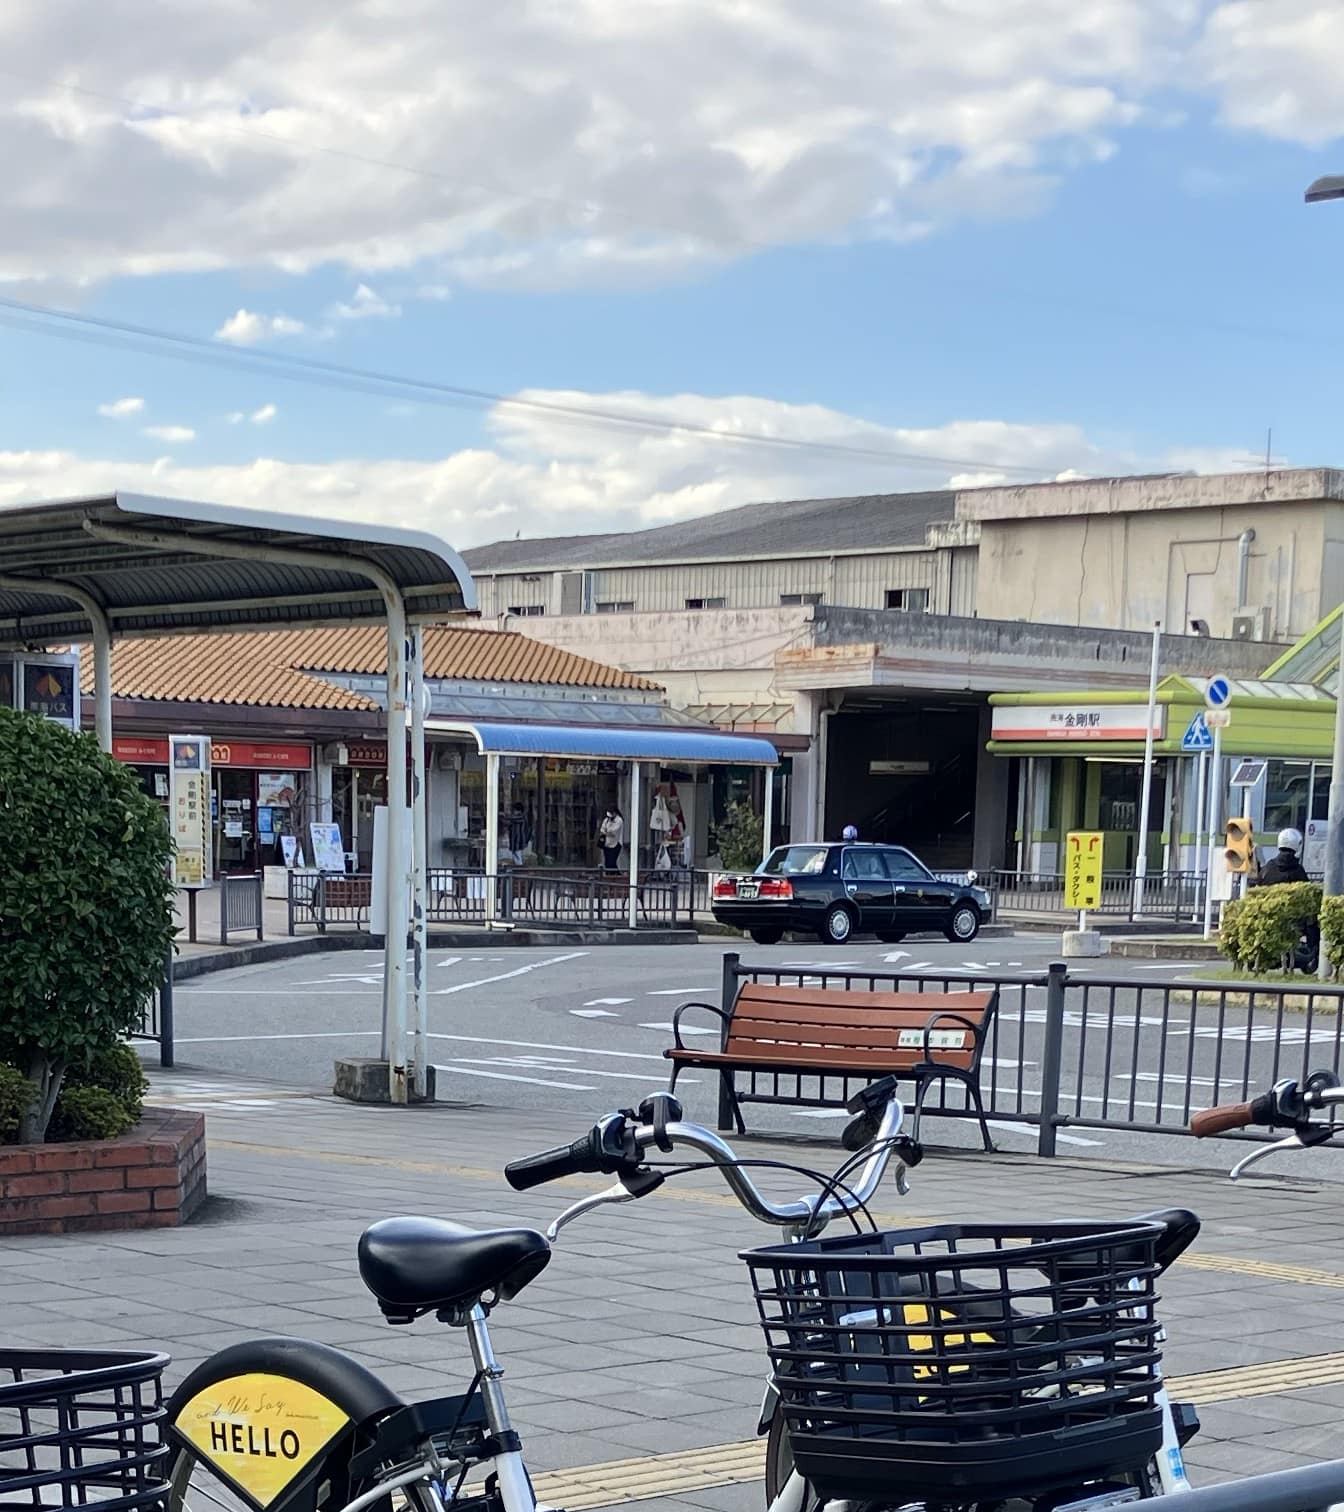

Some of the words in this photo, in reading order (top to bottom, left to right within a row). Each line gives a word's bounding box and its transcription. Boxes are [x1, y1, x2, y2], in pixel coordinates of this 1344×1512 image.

[227, 1396, 250, 1415] We
[255, 1392, 287, 1417] Say
[210, 1421, 300, 1460] HELLO
